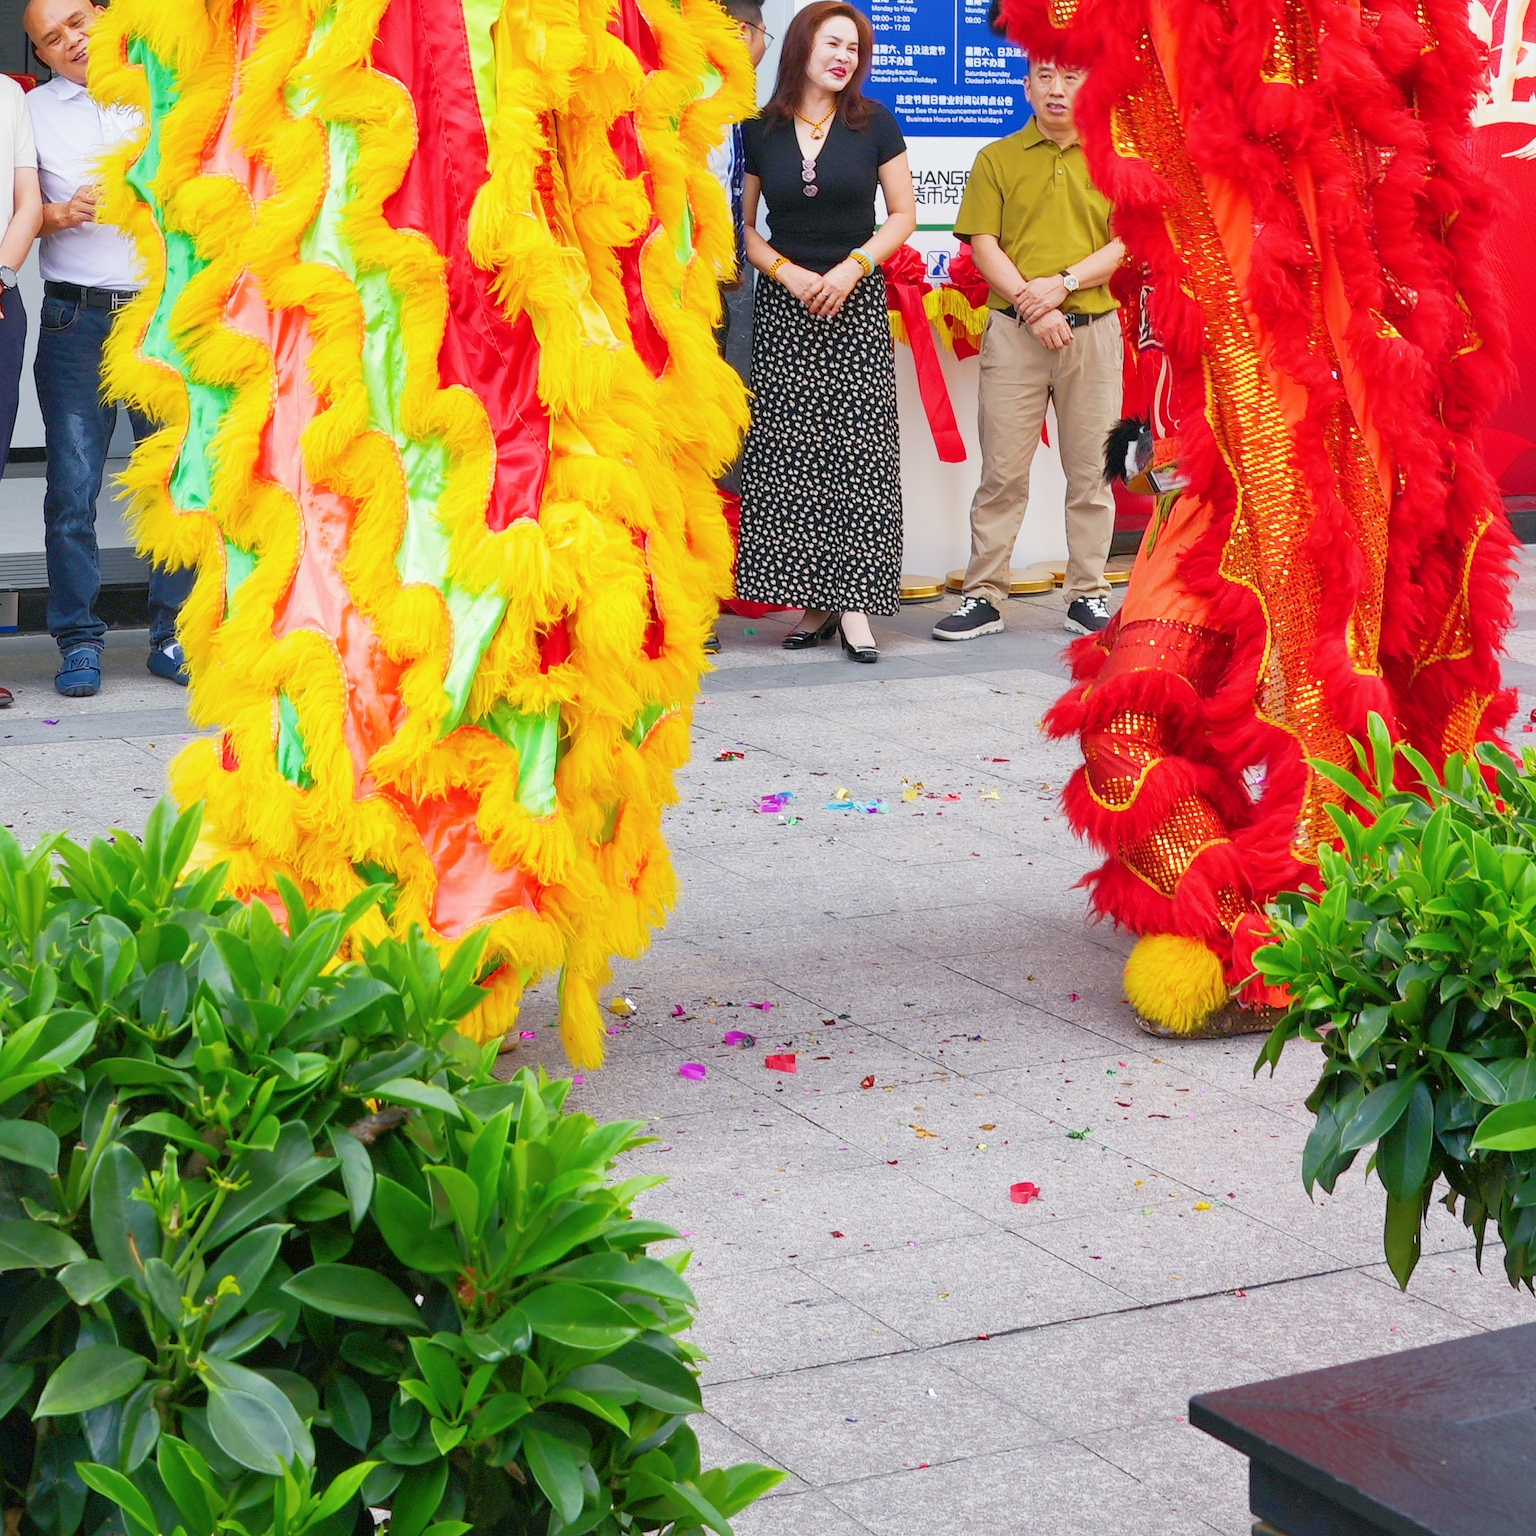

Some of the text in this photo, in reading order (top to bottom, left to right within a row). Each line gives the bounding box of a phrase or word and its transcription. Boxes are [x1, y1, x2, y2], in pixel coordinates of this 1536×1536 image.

[871, 5, 893, 13] Monday
[900, 6, 918, 14] Friday
[965, 6, 987, 15] Monday
[895, 107, 915, 115] Please
[977, 117, 1003, 125] Holidays
[913, 186, 965, 205] 货币兑
